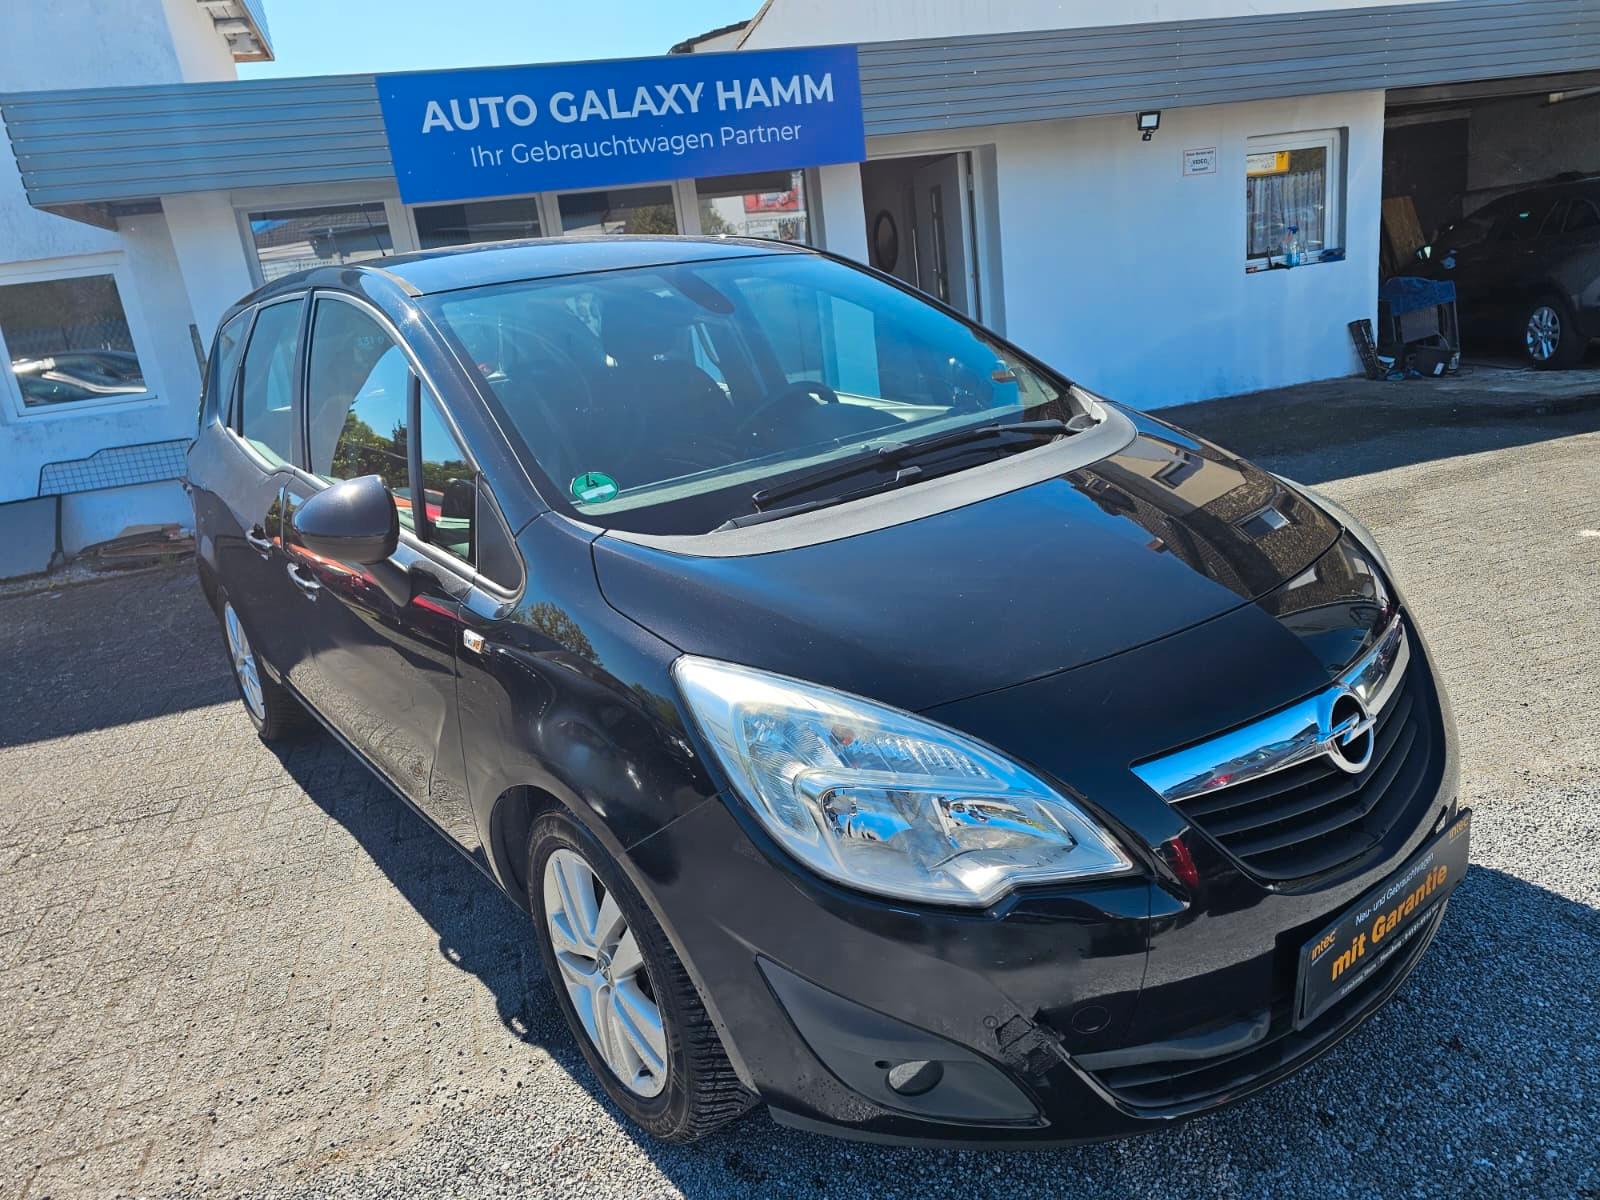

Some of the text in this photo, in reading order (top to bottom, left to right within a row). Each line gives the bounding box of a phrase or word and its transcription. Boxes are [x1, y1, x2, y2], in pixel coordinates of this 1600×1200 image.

[421, 73, 835, 134] AUTO GALAXY HAMM
[471, 124, 803, 168] Ihr Gebrauchtwagen Partner
[1373, 893, 1386, 912] und
[1386, 852, 1434, 900] Gebrauchtwagen
[1331, 932, 1366, 982] mit
[1371, 864, 1448, 944] Garantie
